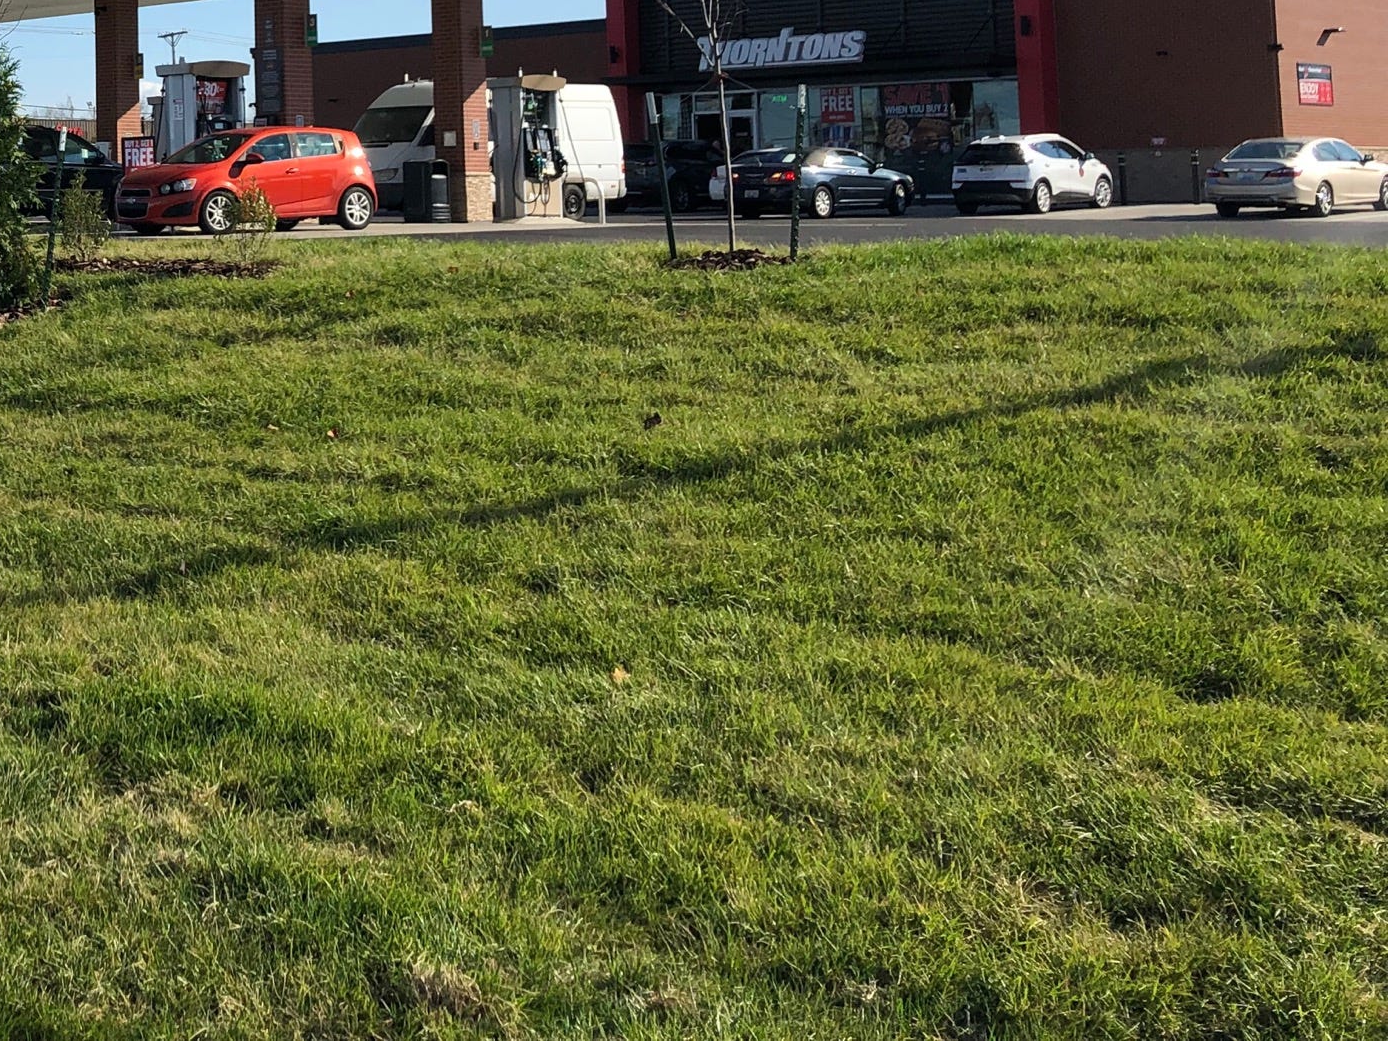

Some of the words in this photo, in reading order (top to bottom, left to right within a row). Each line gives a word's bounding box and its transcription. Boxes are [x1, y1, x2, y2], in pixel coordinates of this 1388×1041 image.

[822, 95, 853, 112] FREE
[884, 105, 908, 114] WHEN
[909, 104, 924, 113] YOU
[925, 103, 941, 113] BUY
[125, 148, 154, 167] FREE
